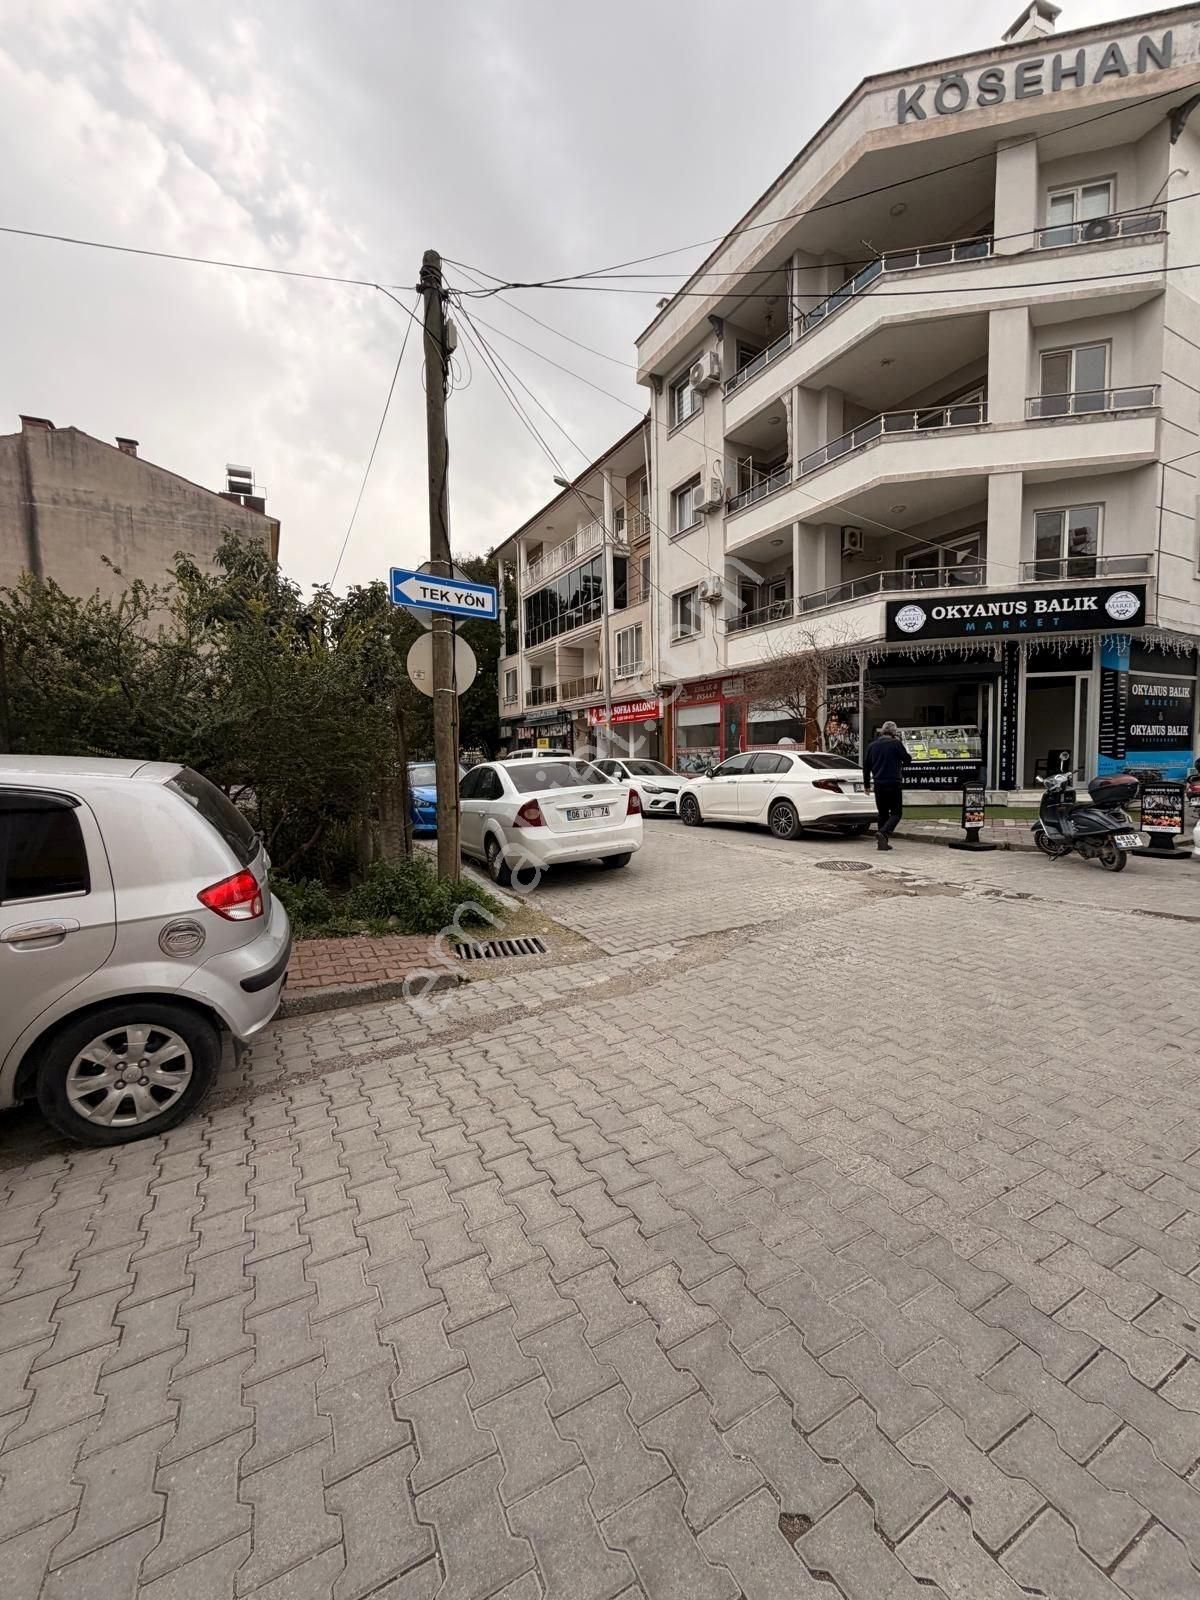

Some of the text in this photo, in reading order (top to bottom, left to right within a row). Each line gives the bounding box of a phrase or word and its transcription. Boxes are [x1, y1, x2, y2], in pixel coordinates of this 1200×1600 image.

[897, 30, 1173, 124] KÖSEHAN
[420, 586, 485, 608] TEK YÖN
[931, 596, 1098, 620] OKYANUS BALIK
[966, 617, 1060, 631] MARKET
[1131, 684, 1190, 698] OKYANUS BALIK
[614, 705, 631, 715] SOFRA
[632, 701, 656, 713] SALONU
[1130, 724, 1189, 736] OKYANUS BALIK
[920, 776, 959, 784] MARKET
